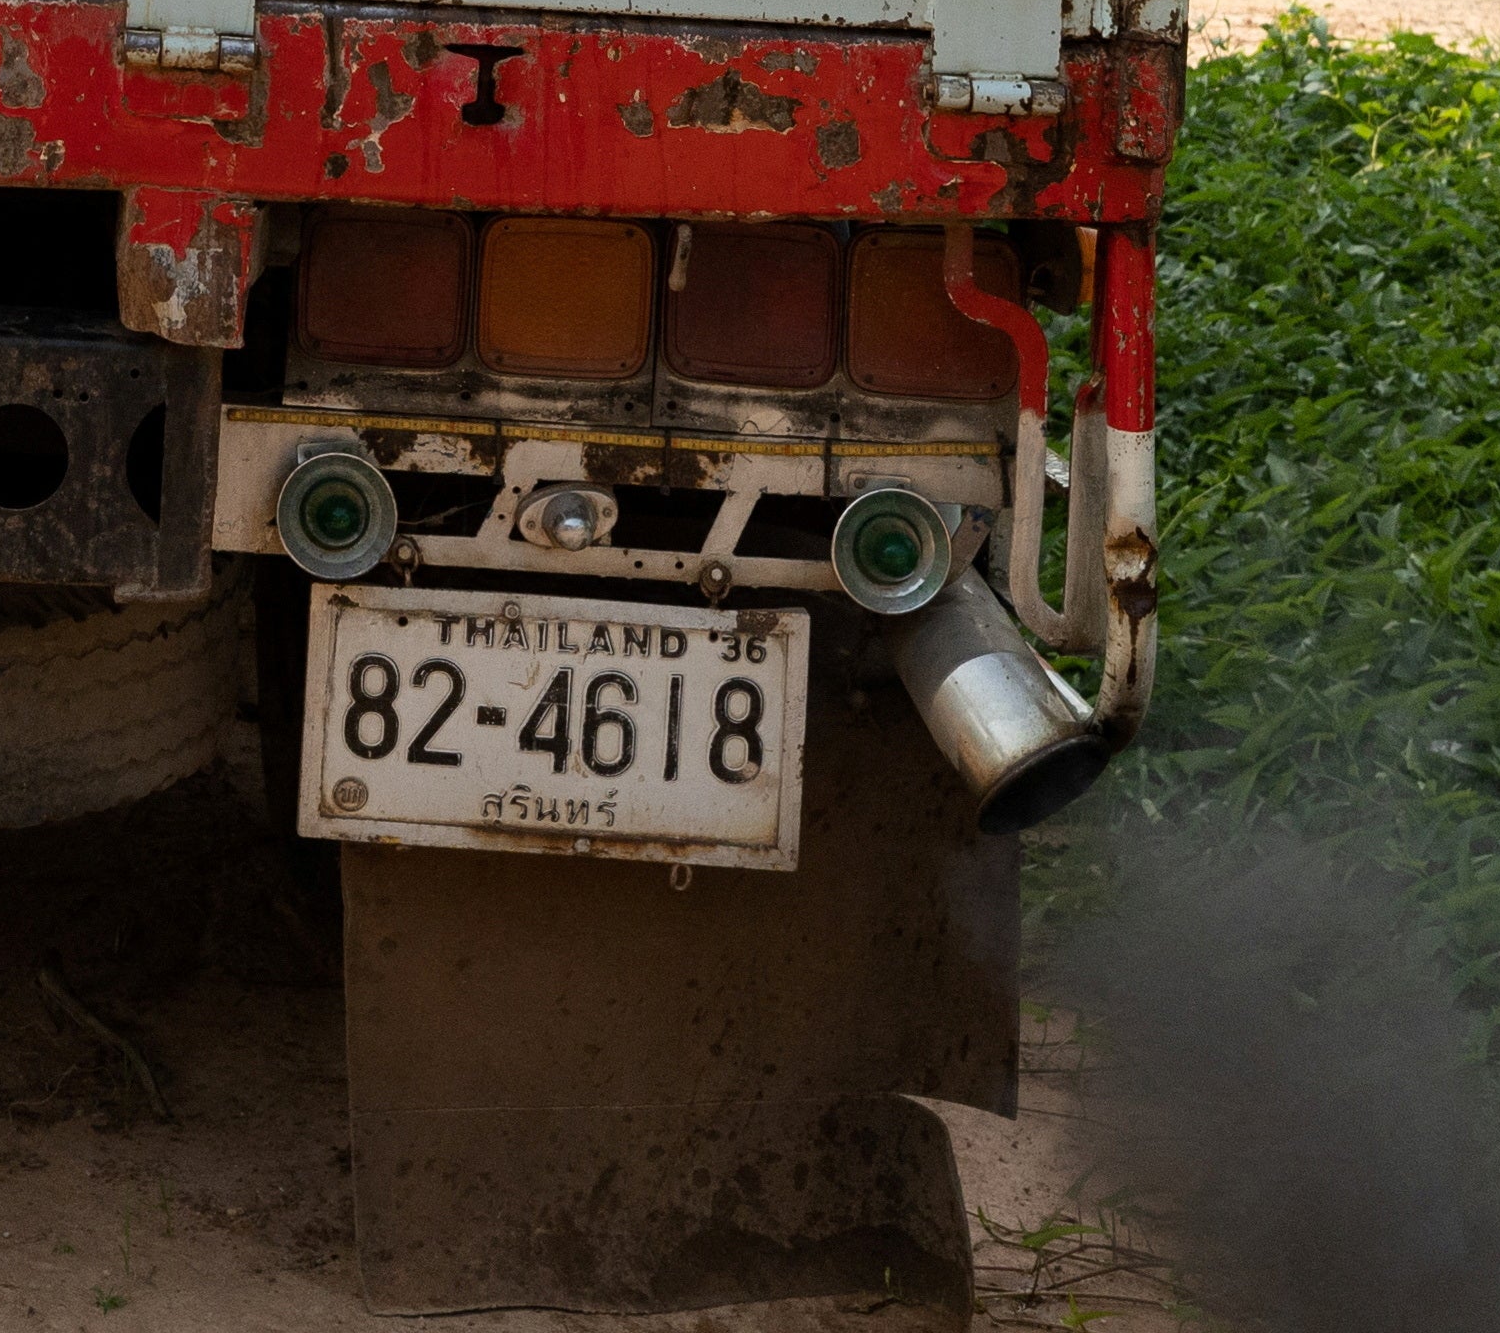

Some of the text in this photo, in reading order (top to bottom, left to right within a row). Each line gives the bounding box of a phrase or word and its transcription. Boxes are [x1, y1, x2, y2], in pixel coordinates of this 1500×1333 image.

[433, 616, 688, 659] THAILAND
[721, 636, 768, 664] 36
[343, 653, 765, 784] 82-4618
[480, 785, 618, 828] สุรินทร์
